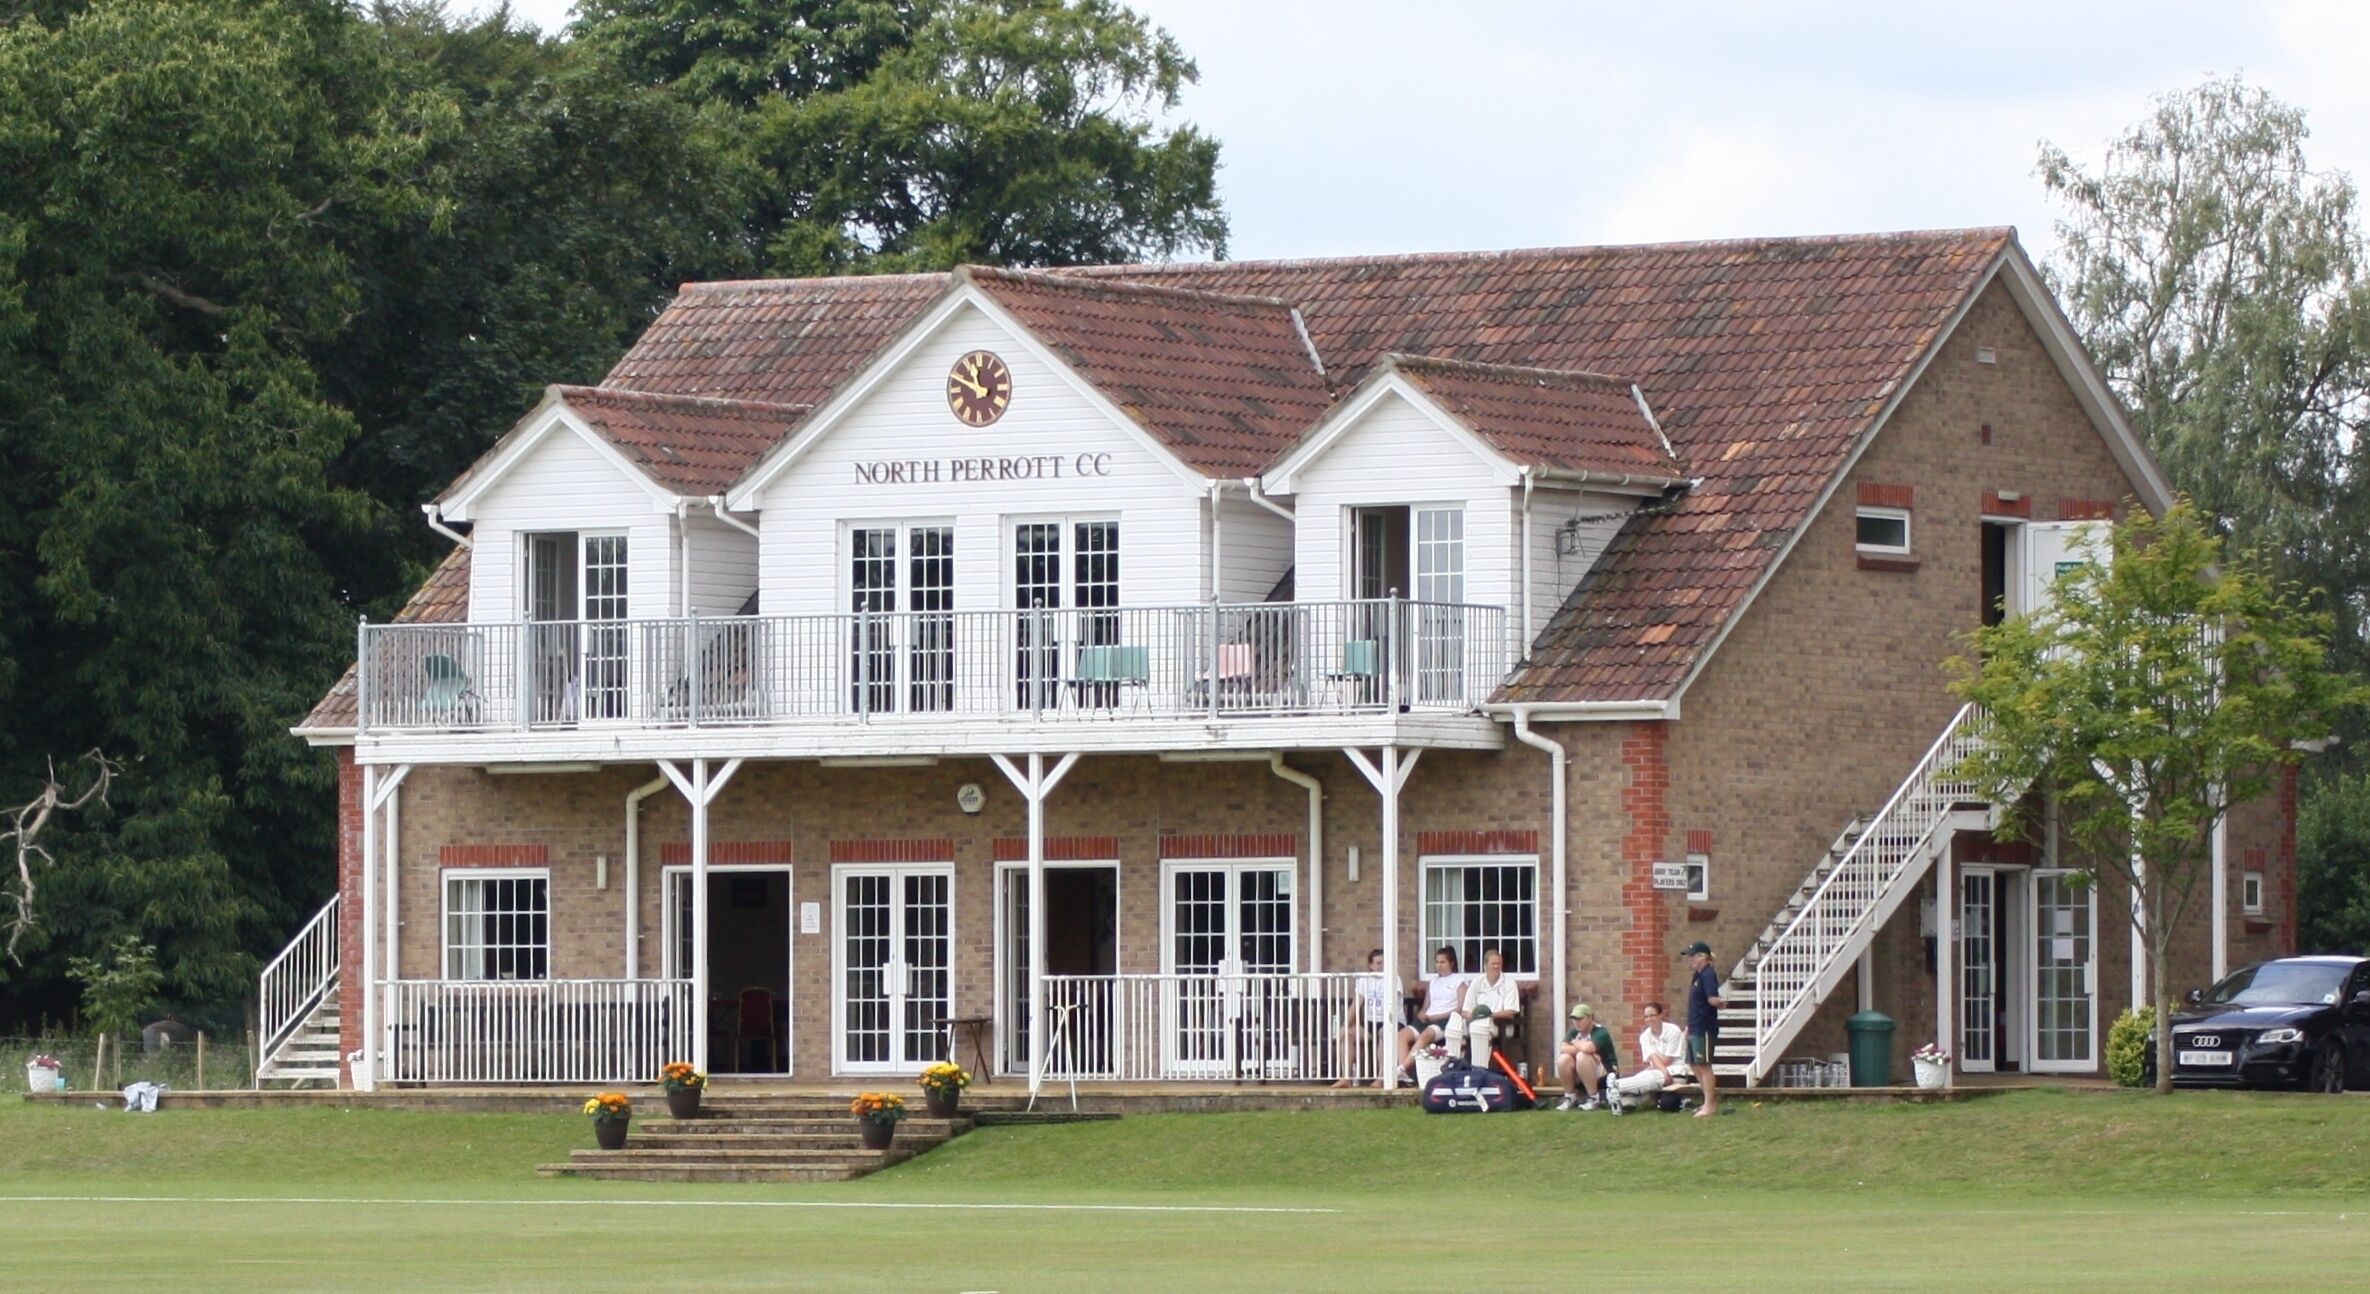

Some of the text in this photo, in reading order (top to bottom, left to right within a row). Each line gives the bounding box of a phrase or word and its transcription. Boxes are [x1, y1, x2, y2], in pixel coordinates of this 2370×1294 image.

[854, 452, 1112, 485] NORTH PERROTT CC
